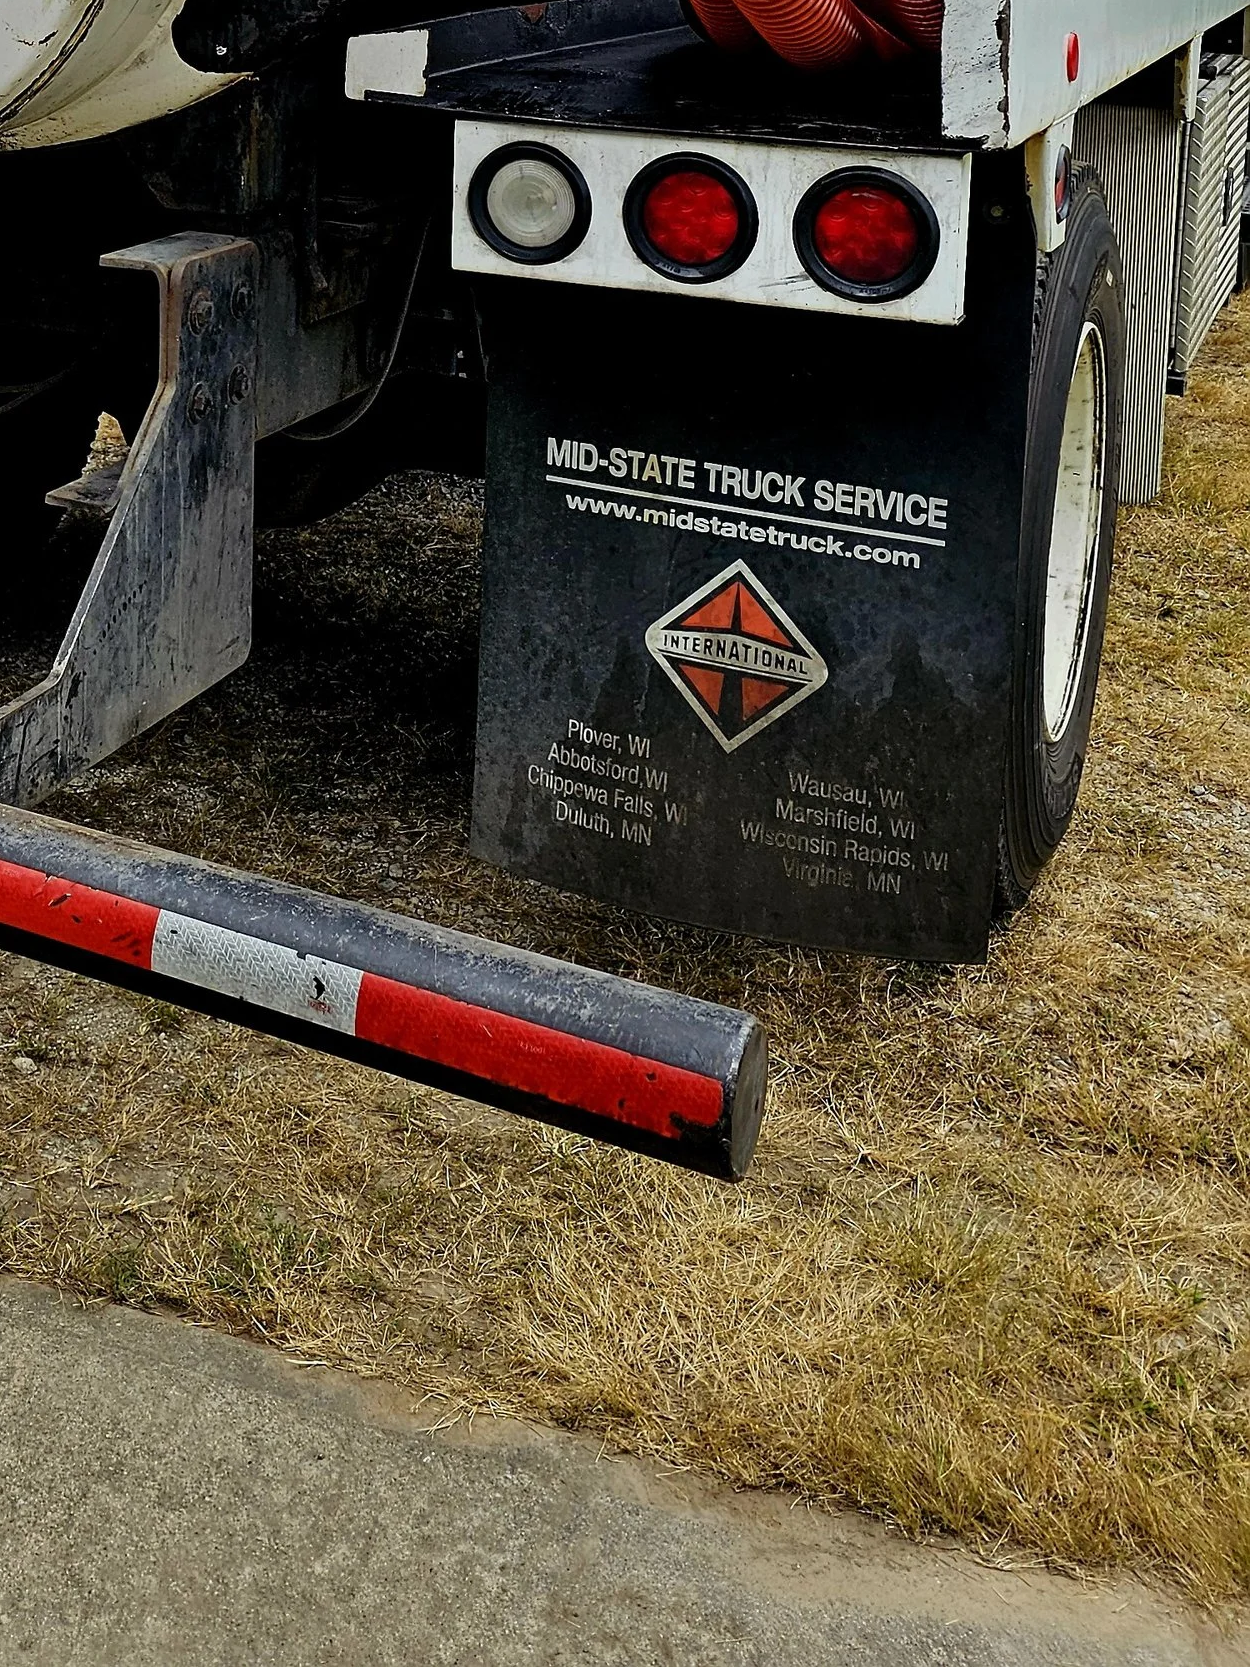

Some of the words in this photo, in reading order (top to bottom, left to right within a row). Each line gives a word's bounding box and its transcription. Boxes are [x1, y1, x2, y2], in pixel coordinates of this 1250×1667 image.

[546, 437, 696, 488] MID-STATE
[703, 462, 806, 507] TRUCK
[814, 479, 948, 530] SERVICE
[565, 494, 921, 569] www.midstatetruck.com
[663, 634, 808, 675] INTERNATIONAL
[568, 718, 622, 755] Plover,
[628, 734, 650, 759] WI
[528, 764, 608, 805] Chippewa
[614, 788, 657, 821] Falls,
[665, 800, 687, 826] WI
[789, 769, 872, 808] Wausau,
[556, 800, 614, 838] Duluth,
[621, 819, 651, 846] MN
[775, 798, 883, 838] Marshfield,
[890, 817, 915, 840] WI
[844, 839, 915, 871] Rapids,
[922, 850, 948, 871] WI
[867, 870, 901, 894] MN
